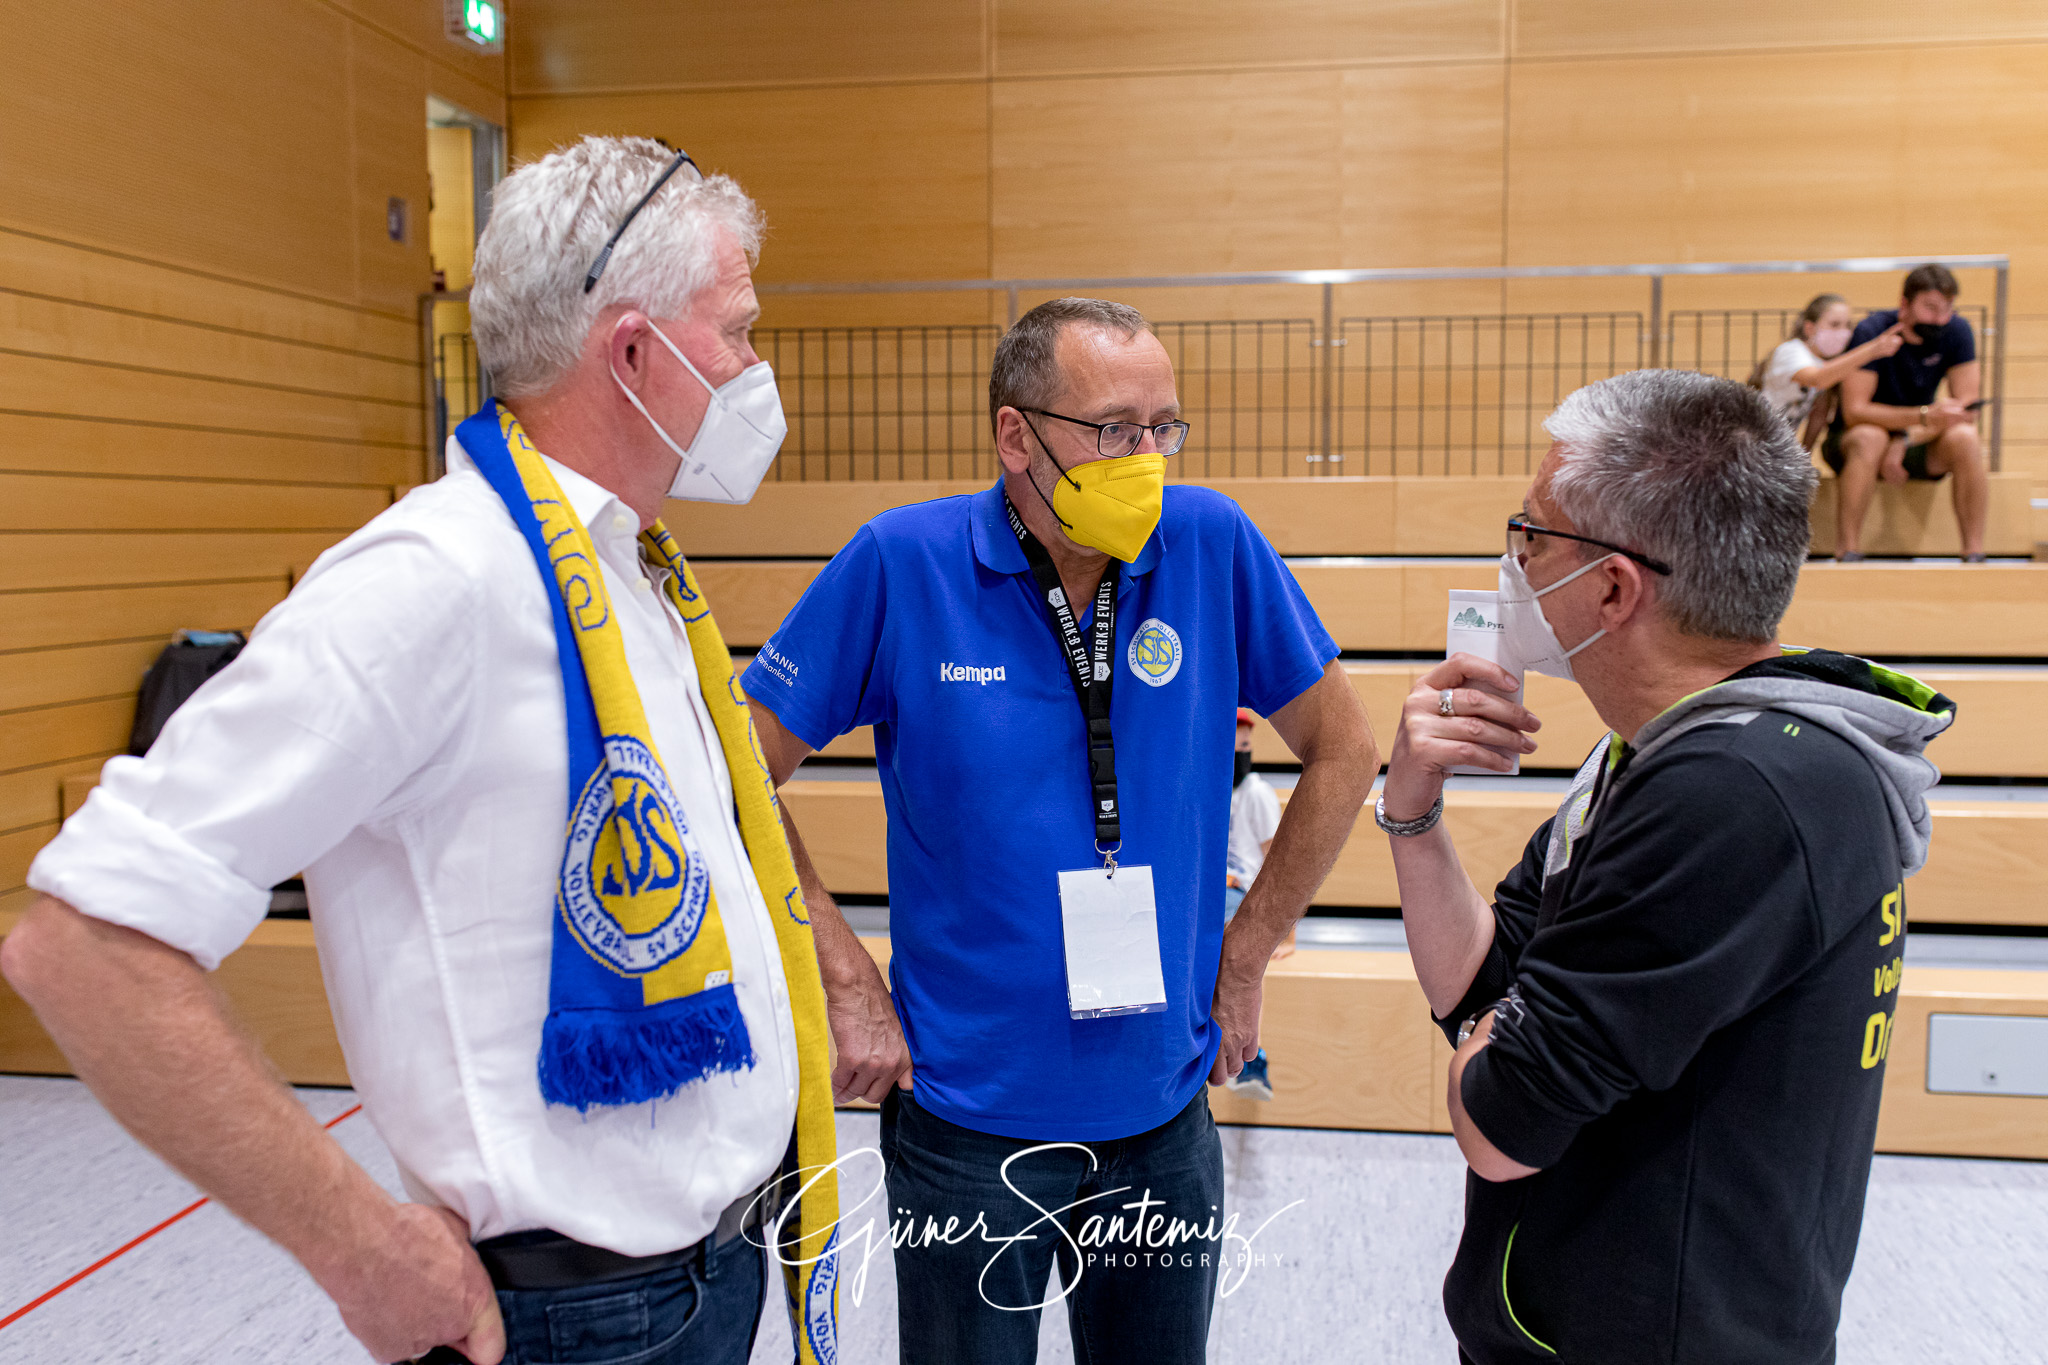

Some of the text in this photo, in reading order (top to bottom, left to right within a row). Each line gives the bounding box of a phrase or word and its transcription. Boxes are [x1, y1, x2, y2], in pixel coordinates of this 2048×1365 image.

[1056, 606, 1081, 646] WERK:B
[1094, 581, 1113, 661] WERK:B EVENTS
[940, 662, 1006, 686] Kempa
